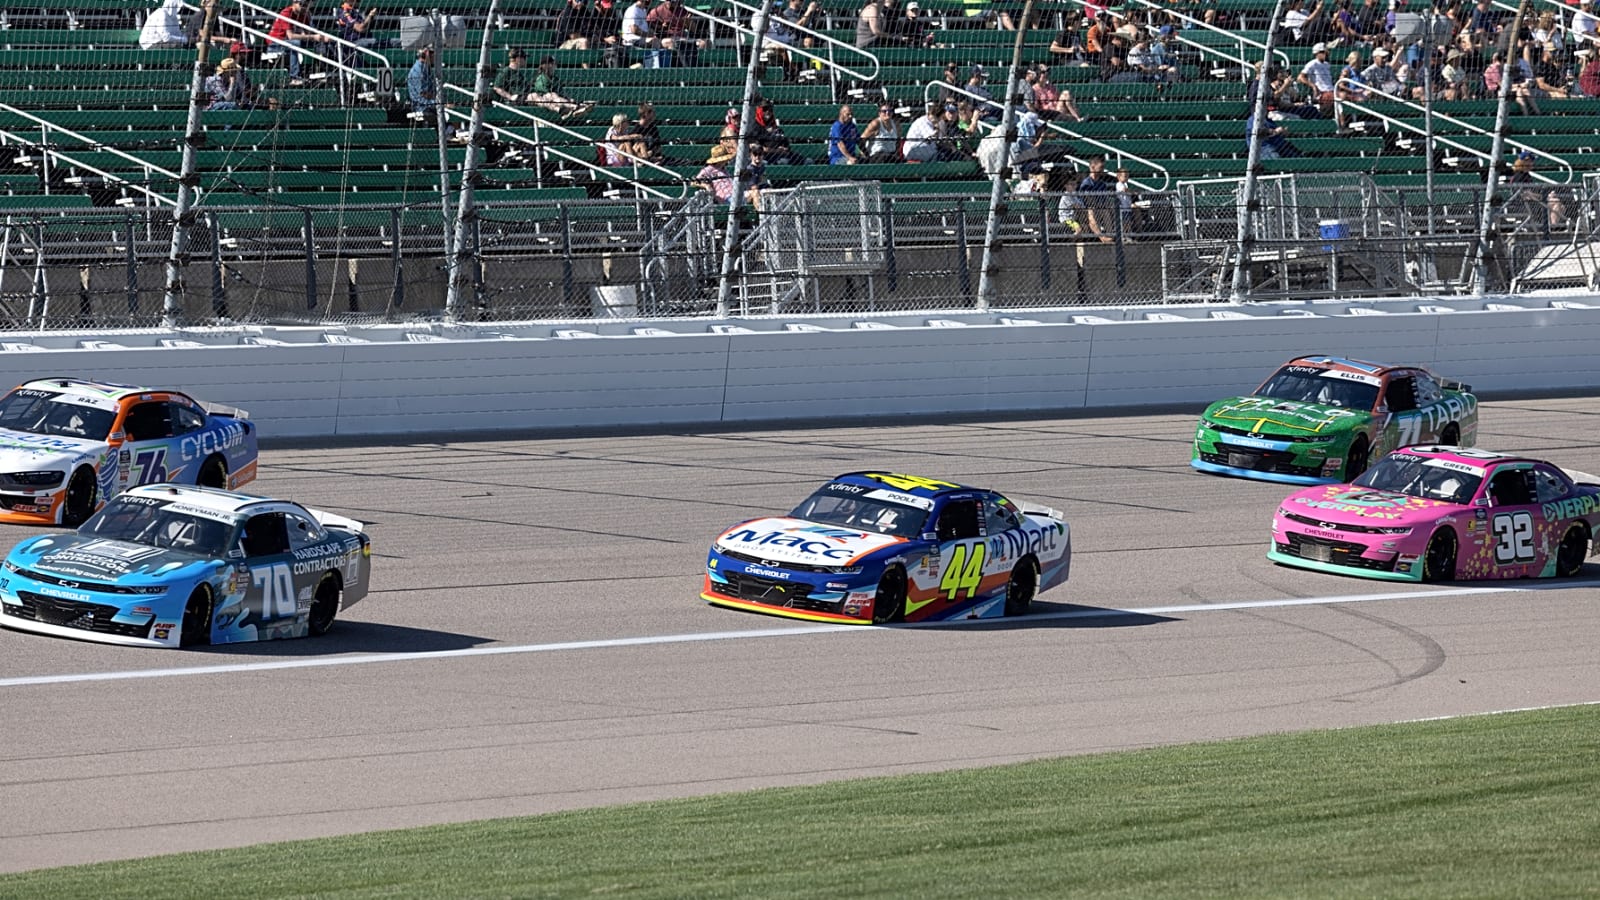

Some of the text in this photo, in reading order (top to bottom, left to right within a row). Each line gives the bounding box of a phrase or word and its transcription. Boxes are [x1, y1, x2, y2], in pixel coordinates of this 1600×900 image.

[379, 70, 392, 92] 10
[1287, 366, 1319, 374] xfinity
[1340, 372, 1366, 381] ELLIS
[16, 389, 51, 398] xfinity
[77, 397, 98, 405] RAZ
[1421, 392, 1477, 432] TABLO
[1397, 413, 1422, 447] 71
[181, 423, 243, 461] CYCLUM
[1390, 452, 1422, 461] xfinity
[134, 448, 168, 486] 76
[1443, 462, 1472, 472] GREEN
[828, 483, 864, 493] xfinity
[120, 496, 160, 506] xfinity
[887, 493, 916, 504] POOLE
[172, 504, 219, 518] HONEYMAN
[1294, 497, 1401, 520] OVERPLAY
[1304, 527, 1344, 539] CHEVROLET
[1493, 510, 1536, 566] 32
[725, 529, 854, 559] Macc
[1004, 525, 1057, 560] Macc
[293, 542, 342, 560] HARDSCAPE
[294, 555, 346, 575] CONTRACTORS
[745, 566, 790, 579] CHEVROLET
[939, 541, 985, 600] 44
[40, 587, 90, 601] CHEVROLET
[251, 562, 297, 621] 70
